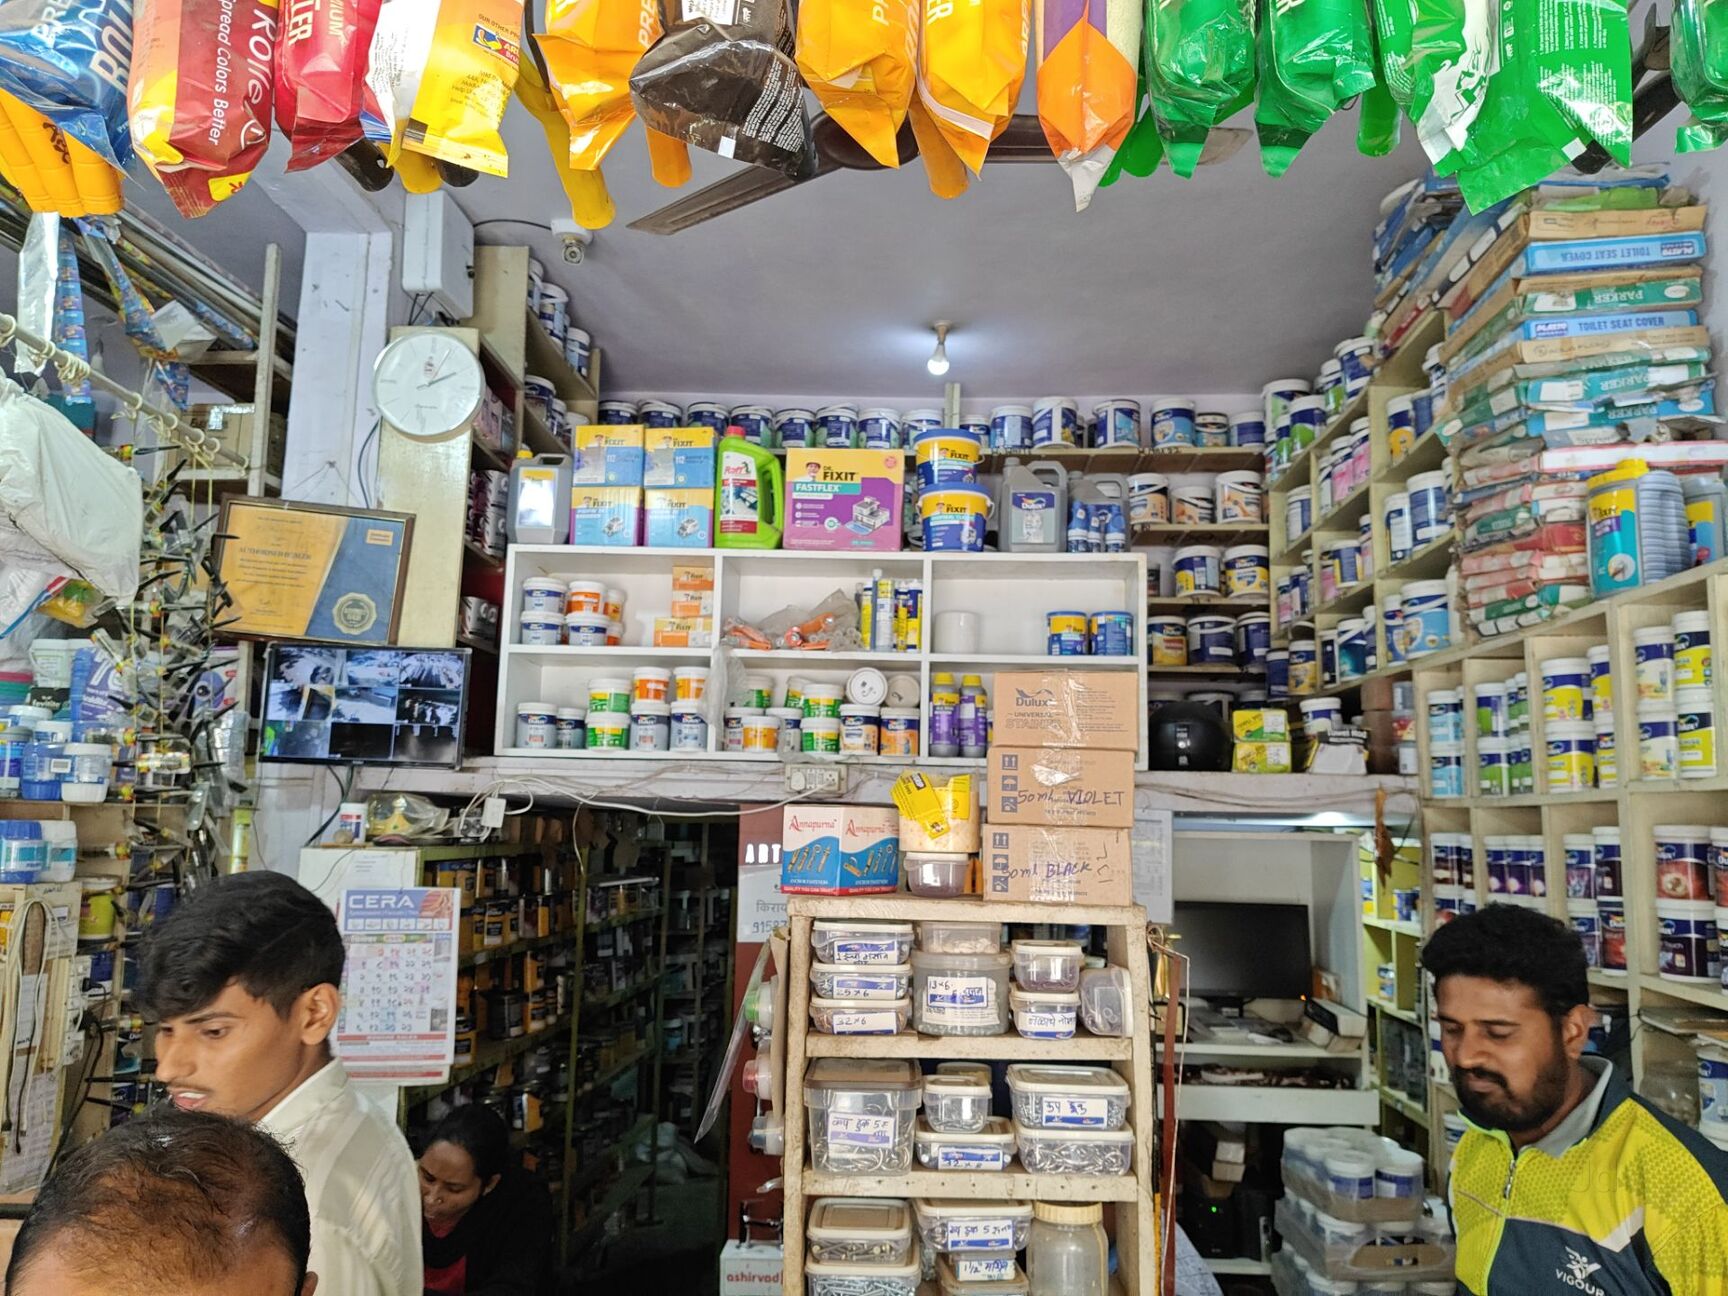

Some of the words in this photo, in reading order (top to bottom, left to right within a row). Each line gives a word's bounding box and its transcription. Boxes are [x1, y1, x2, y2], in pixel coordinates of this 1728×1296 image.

[217, 0, 238, 46] pread
[214, 48, 232, 94] Colors
[208, 98, 229, 146] Better
[1594, 289, 1644, 304] PARKER
[1578, 321, 1608, 331] TOILET
[1611, 319, 1633, 329] SEAT
[1636, 316, 1665, 327] COVER
[823, 471, 856, 481] FIXIT
[795, 483, 840, 492] FASTFLEX
[1016, 696, 1048, 707] Dulux
[1066, 788, 1125, 806] VIOLET
[789, 815, 835, 832] Annapurna
[1045, 861, 1092, 878] BLACK
[348, 894, 415, 910] CERA
[727, 1272, 780, 1283] ashirvad
[1555, 1268, 1604, 1296] VIGOUR
